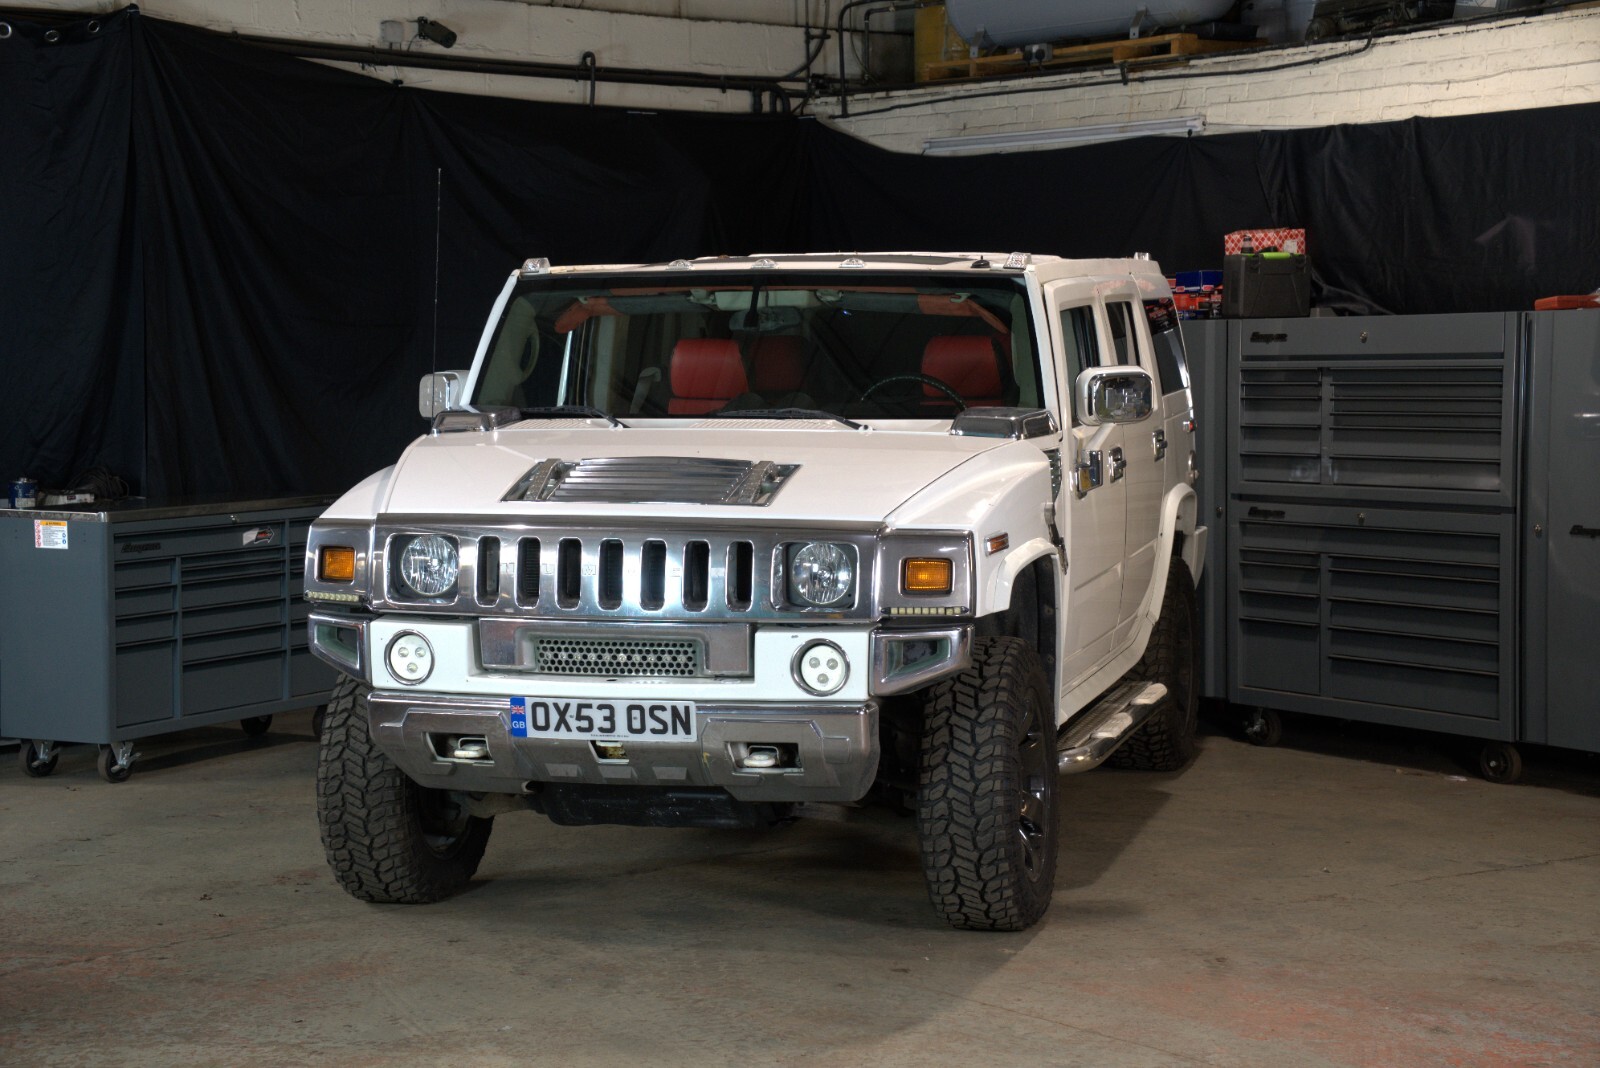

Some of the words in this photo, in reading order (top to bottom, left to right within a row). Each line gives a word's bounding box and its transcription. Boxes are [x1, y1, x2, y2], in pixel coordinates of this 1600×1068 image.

[512, 720, 526, 729] GB
[531, 701, 616, 734] OX53
[626, 704, 692, 735] OSN
